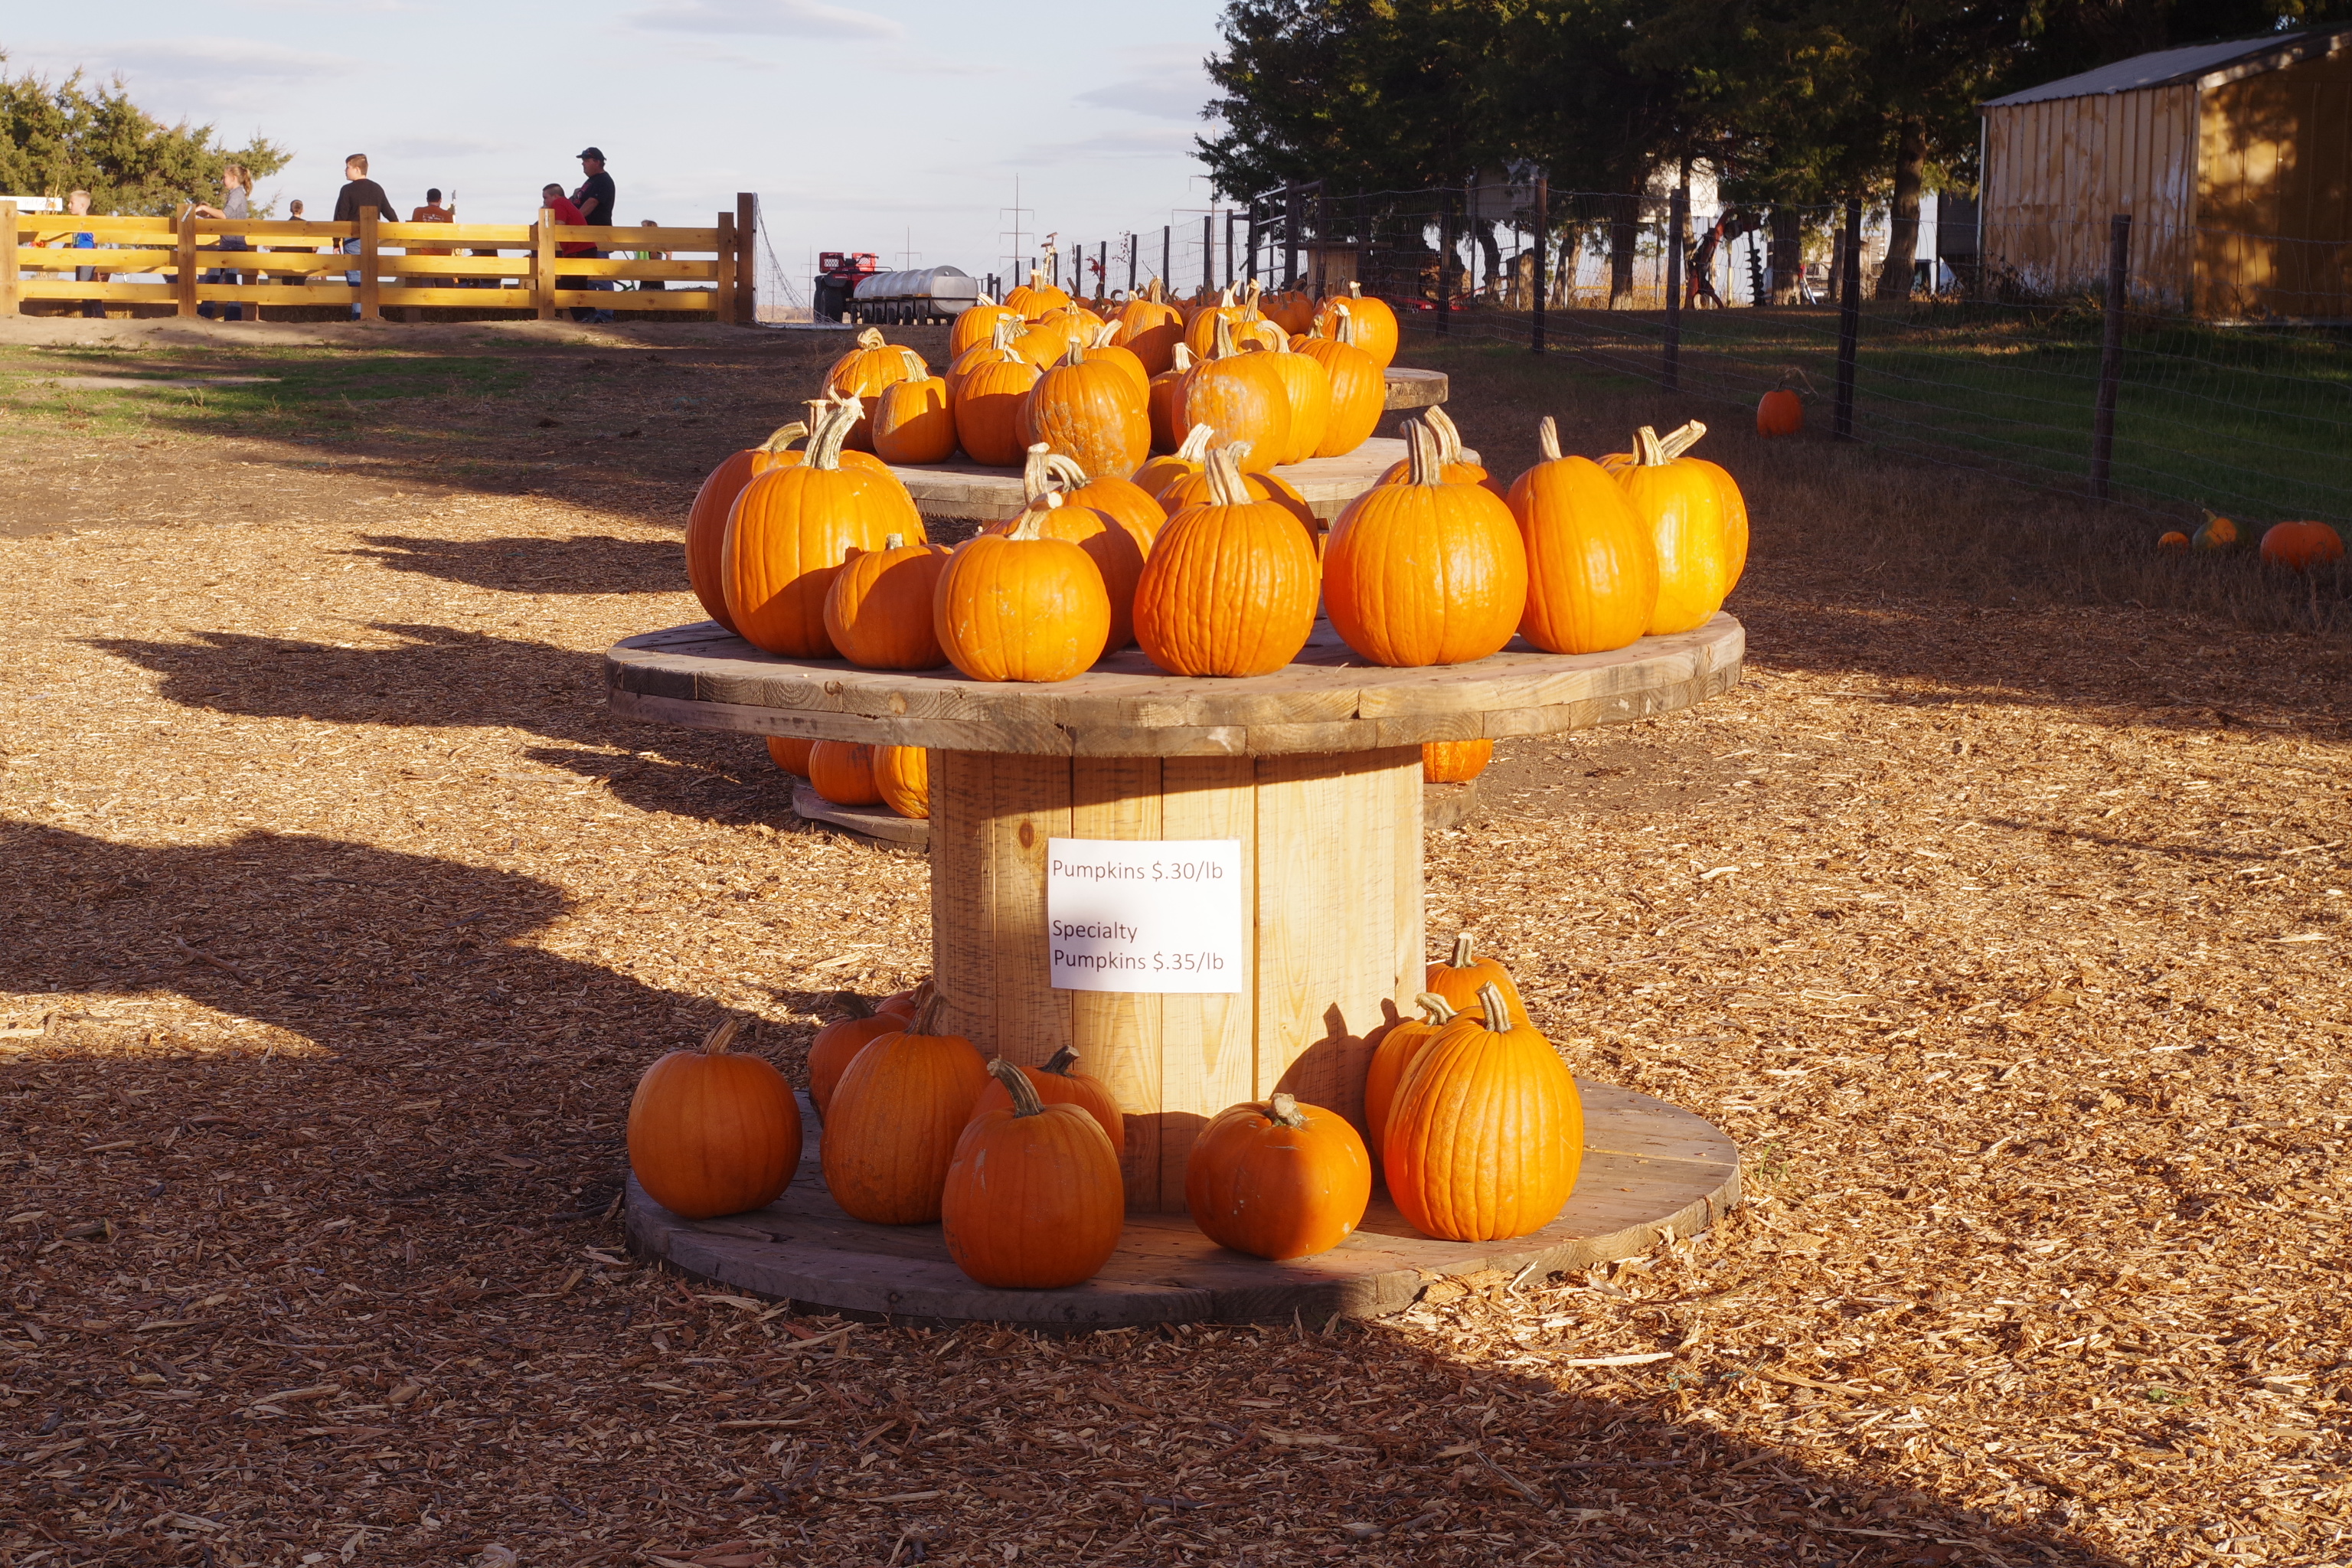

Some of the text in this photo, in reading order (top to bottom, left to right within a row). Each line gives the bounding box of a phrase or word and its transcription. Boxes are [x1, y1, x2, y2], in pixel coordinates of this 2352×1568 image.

[1053, 859, 1223, 883] Pumpkins $.30/lb
[1053, 920, 1138, 944] Specialty
[1054, 949, 1224, 973] Pumpkins $.35/lb
